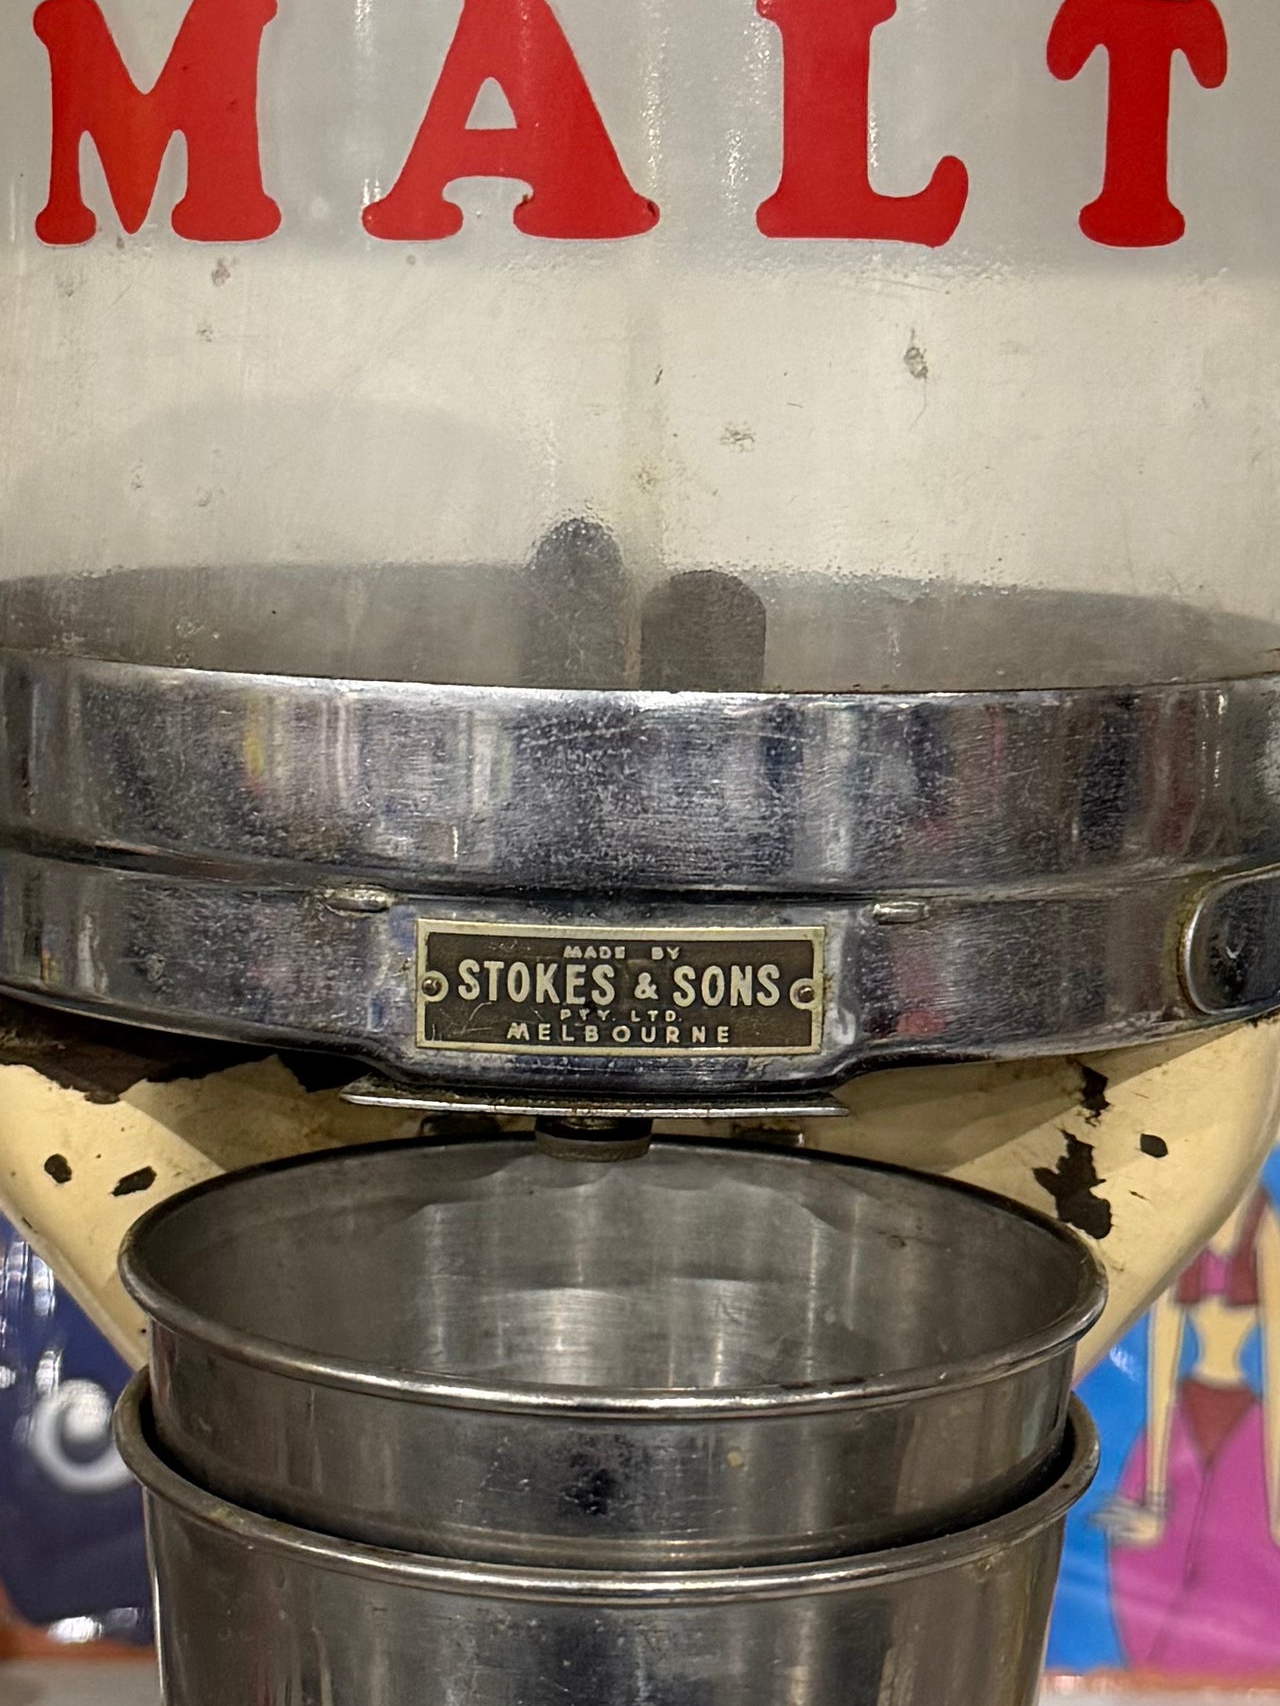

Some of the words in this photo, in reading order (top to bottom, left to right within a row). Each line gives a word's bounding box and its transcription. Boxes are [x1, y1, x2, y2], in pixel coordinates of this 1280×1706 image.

[562, 945, 626, 960] MADE
[650, 946, 681, 961] BY
[457, 958, 616, 1006] STOKES
[634, 972, 660, 1000] &
[672, 964, 781, 1008] SONS
[560, 1008, 617, 1022] PTY.
[631, 1010, 683, 1022] LTD.
[506, 1022, 730, 1044] MELBOURNE
